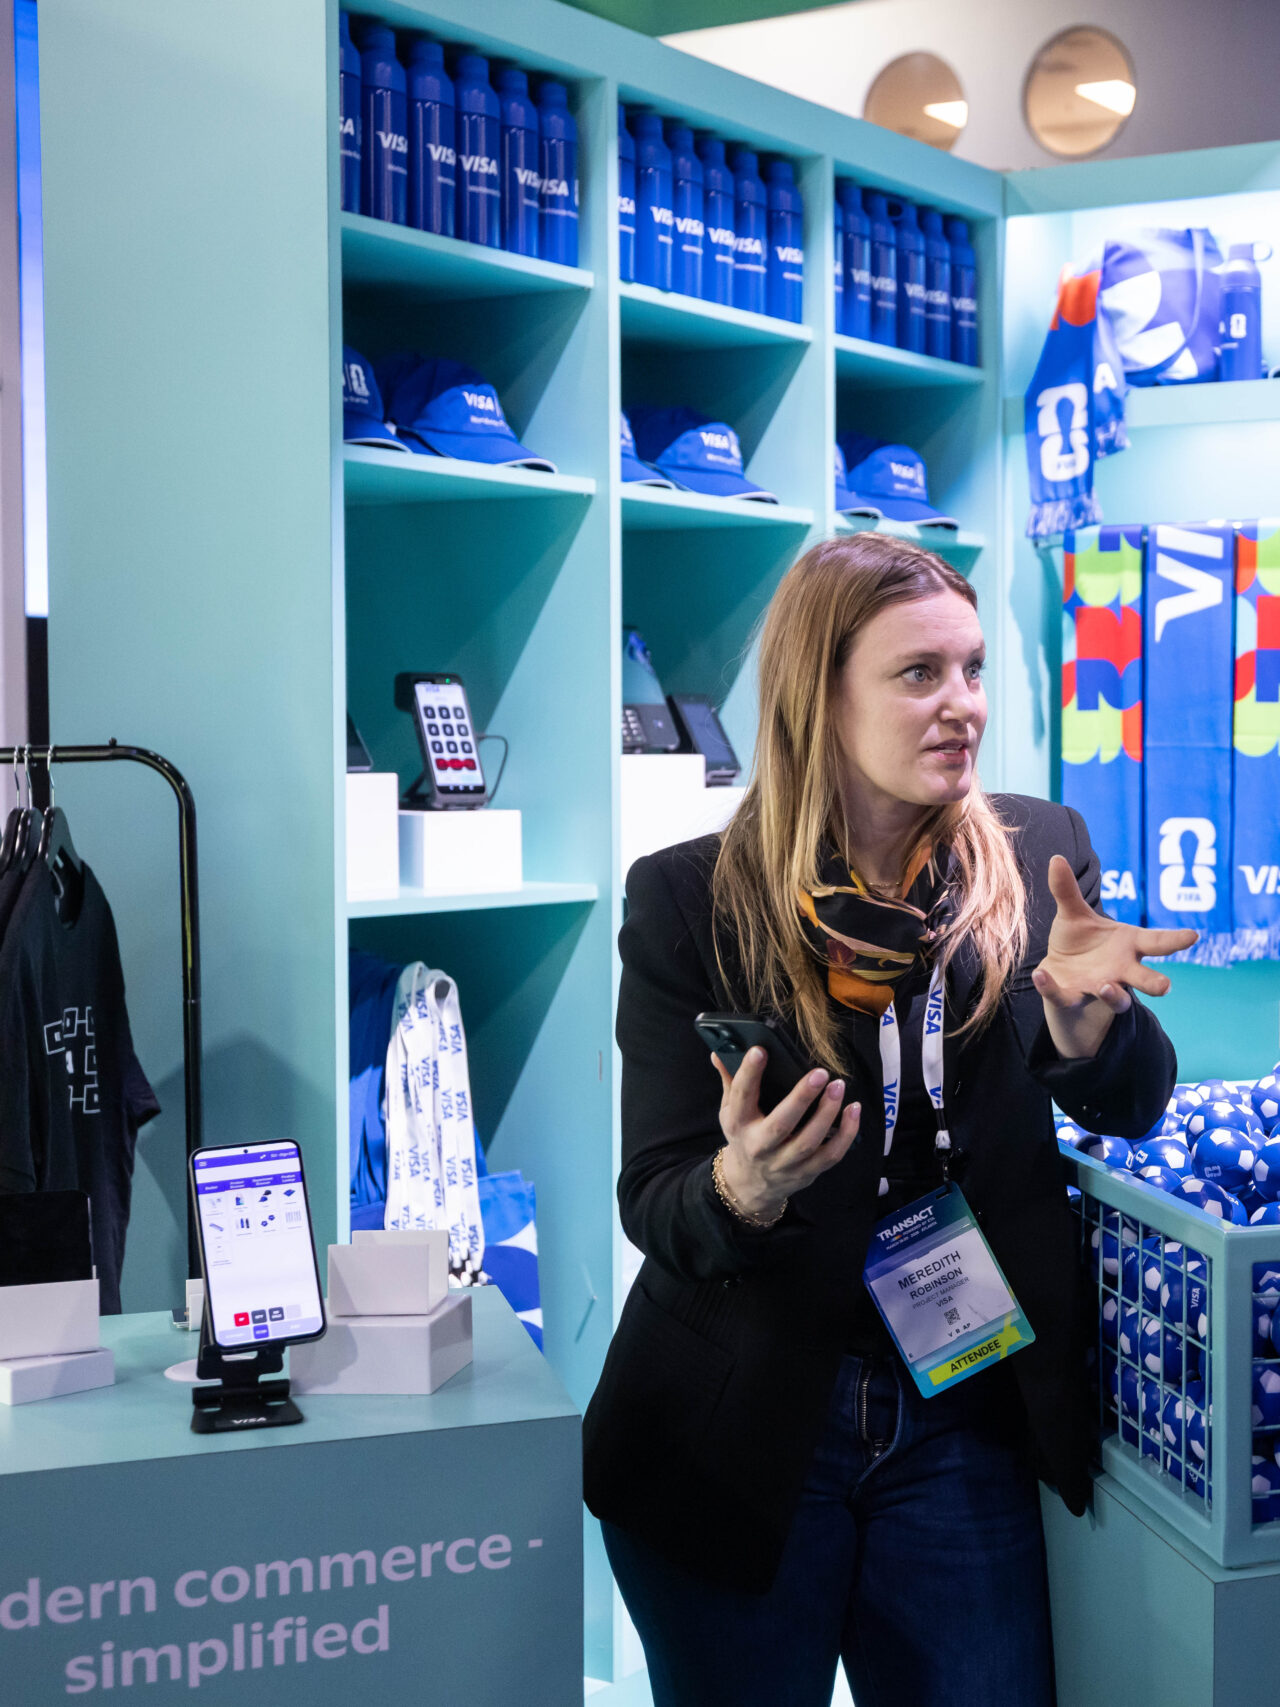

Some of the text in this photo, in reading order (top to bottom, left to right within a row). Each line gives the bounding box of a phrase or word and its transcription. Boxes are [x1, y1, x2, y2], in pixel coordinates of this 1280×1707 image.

[459, 154, 498, 176] VISA
[514, 167, 540, 188] VIS
[463, 391, 496, 411] VISA
[926, 988, 942, 1035] VISA
[456, 1091, 468, 1121] VISA
[883, 1078, 898, 1129] VISA
[462, 1158, 473, 1188] VISA
[877, 1205, 934, 1241] TRANSACT
[898, 1250, 961, 1290] MEREDITH
[910, 1267, 963, 1300] ROBINSON
[912, 1276, 970, 1309] PROJECT MANAGER
[936, 1295, 954, 1307] VISA
[1191, 1288, 1201, 1308] VISA
[950, 1339, 1002, 1373] ATTENDEE
[230, 1416, 268, 1425] VISA
[0, 1577, 157, 1630] dern
[174, 1533, 512, 1608] commerce
[65, 1604, 391, 1694] simplified
